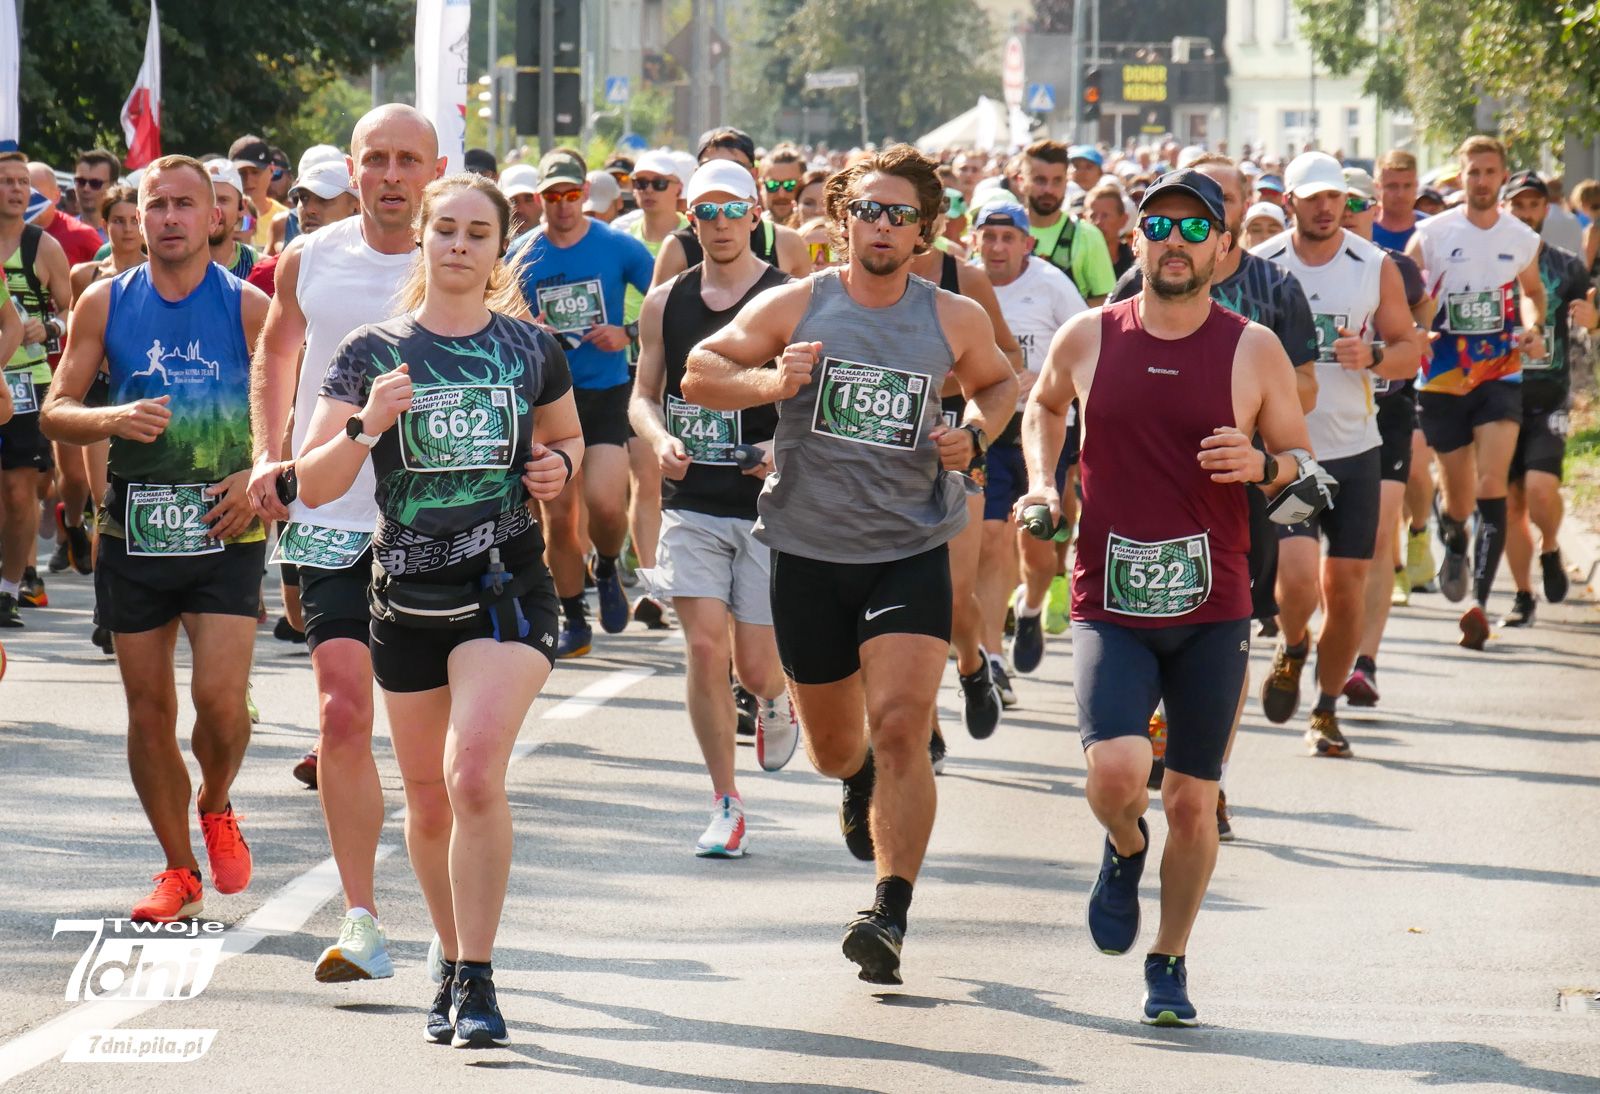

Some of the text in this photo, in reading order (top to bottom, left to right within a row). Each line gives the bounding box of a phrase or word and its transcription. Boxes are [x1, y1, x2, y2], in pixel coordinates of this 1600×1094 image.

[1122, 83, 1168, 102] KEBAB
[555, 295, 589, 315] 499
[1460, 301, 1492, 318] 858
[831, 368, 881, 378] PÓŁMARATON
[832, 374, 861, 382] SIGNIFY
[410, 398, 459, 412] SIGNIFY PIŁA
[411, 391, 460, 404] ÓŁMARATON
[838, 383, 910, 419] 1580
[428, 409, 490, 439] 662
[680, 417, 720, 441] 244
[147, 505, 199, 530] 402
[1113, 545, 1160, 555] PÓŁMARATON
[1116, 552, 1141, 561] SIGNIFY
[1129, 561, 1185, 589] 522
